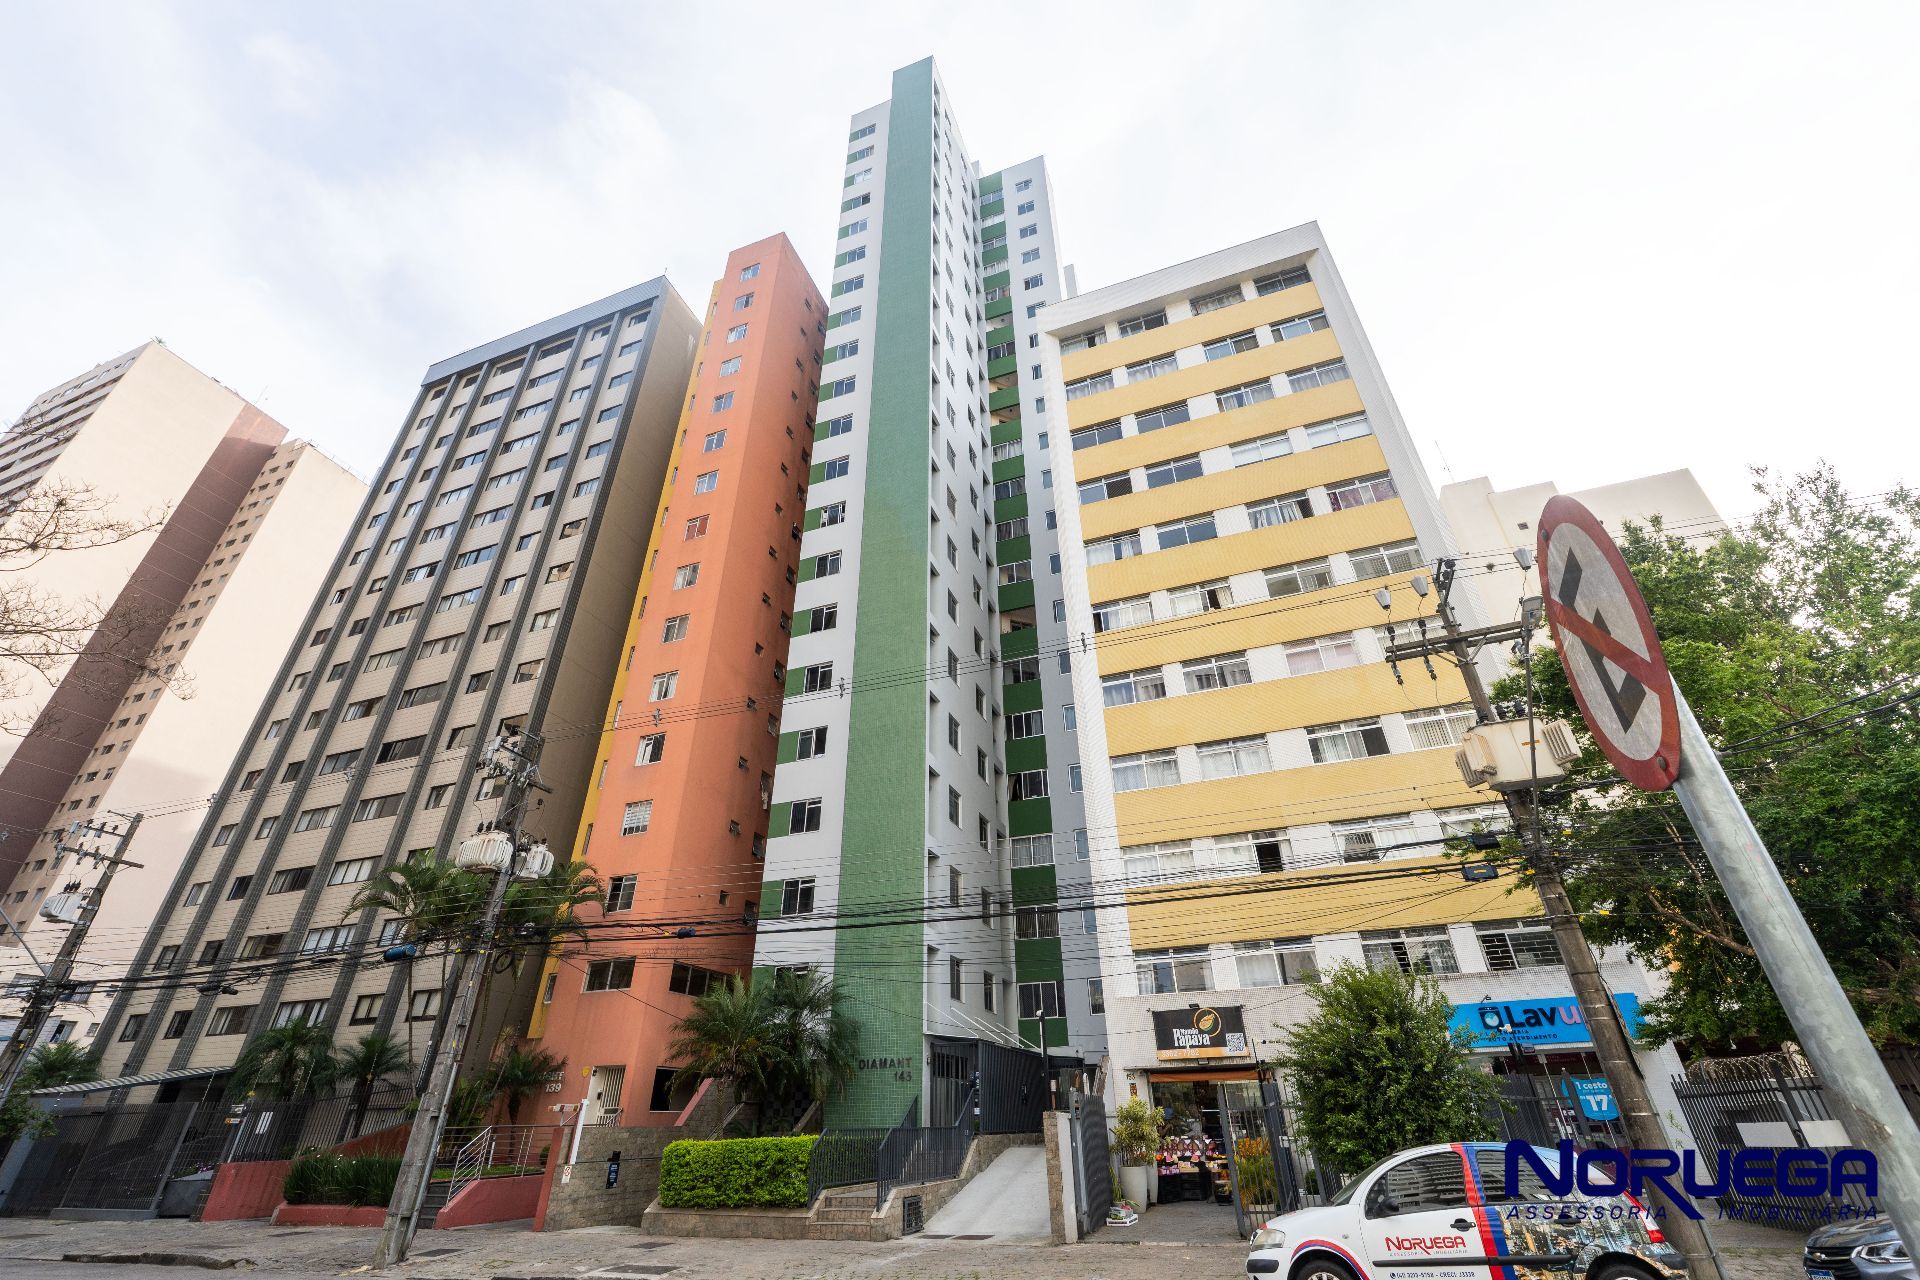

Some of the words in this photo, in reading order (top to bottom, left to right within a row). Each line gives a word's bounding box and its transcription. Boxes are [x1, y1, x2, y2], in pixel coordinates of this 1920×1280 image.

[1504, 1005, 1583, 1028] Lavu
[1173, 1029, 1210, 1049] Papaya
[858, 1057, 912, 1070] DIAMANT
[545, 1083, 562, 1093] 139
[1583, 1081, 1608, 1090] cesto
[1586, 1095, 1608, 1111] 17
[1385, 1236, 1466, 1255] NORUEGA
